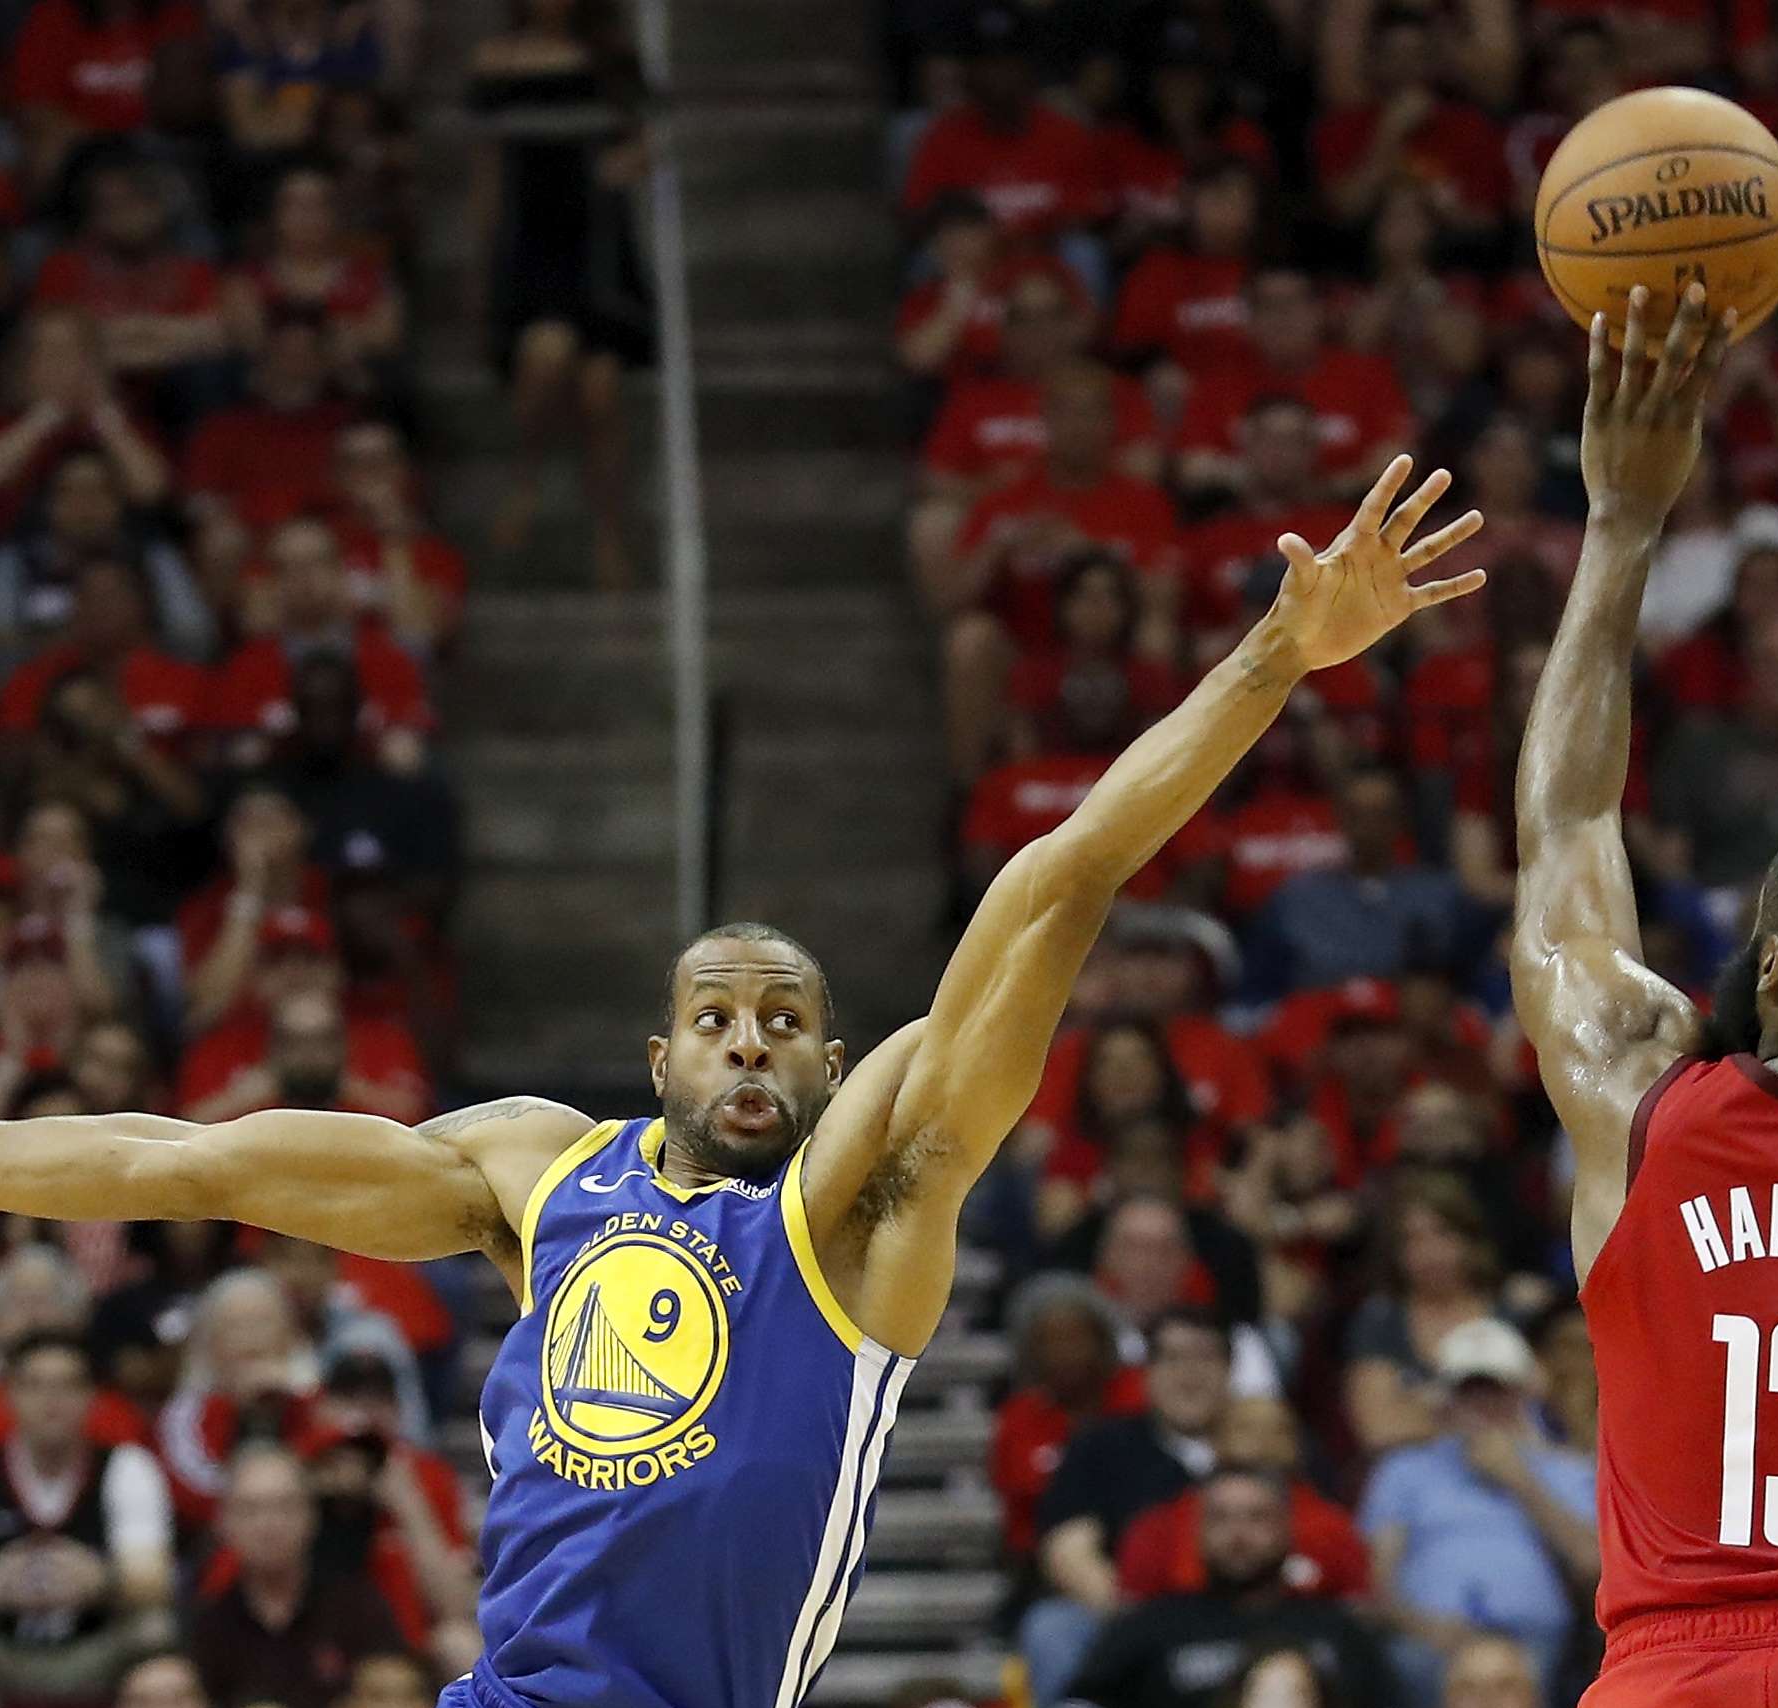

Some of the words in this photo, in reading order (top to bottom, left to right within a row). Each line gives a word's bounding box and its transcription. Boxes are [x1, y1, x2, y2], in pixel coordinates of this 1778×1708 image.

[1586, 176, 1767, 245] SPALDING
[669, 1220, 743, 1297] STATE
[643, 1288, 681, 1343] 9
[528, 1404, 717, 1490] WARRIORS
